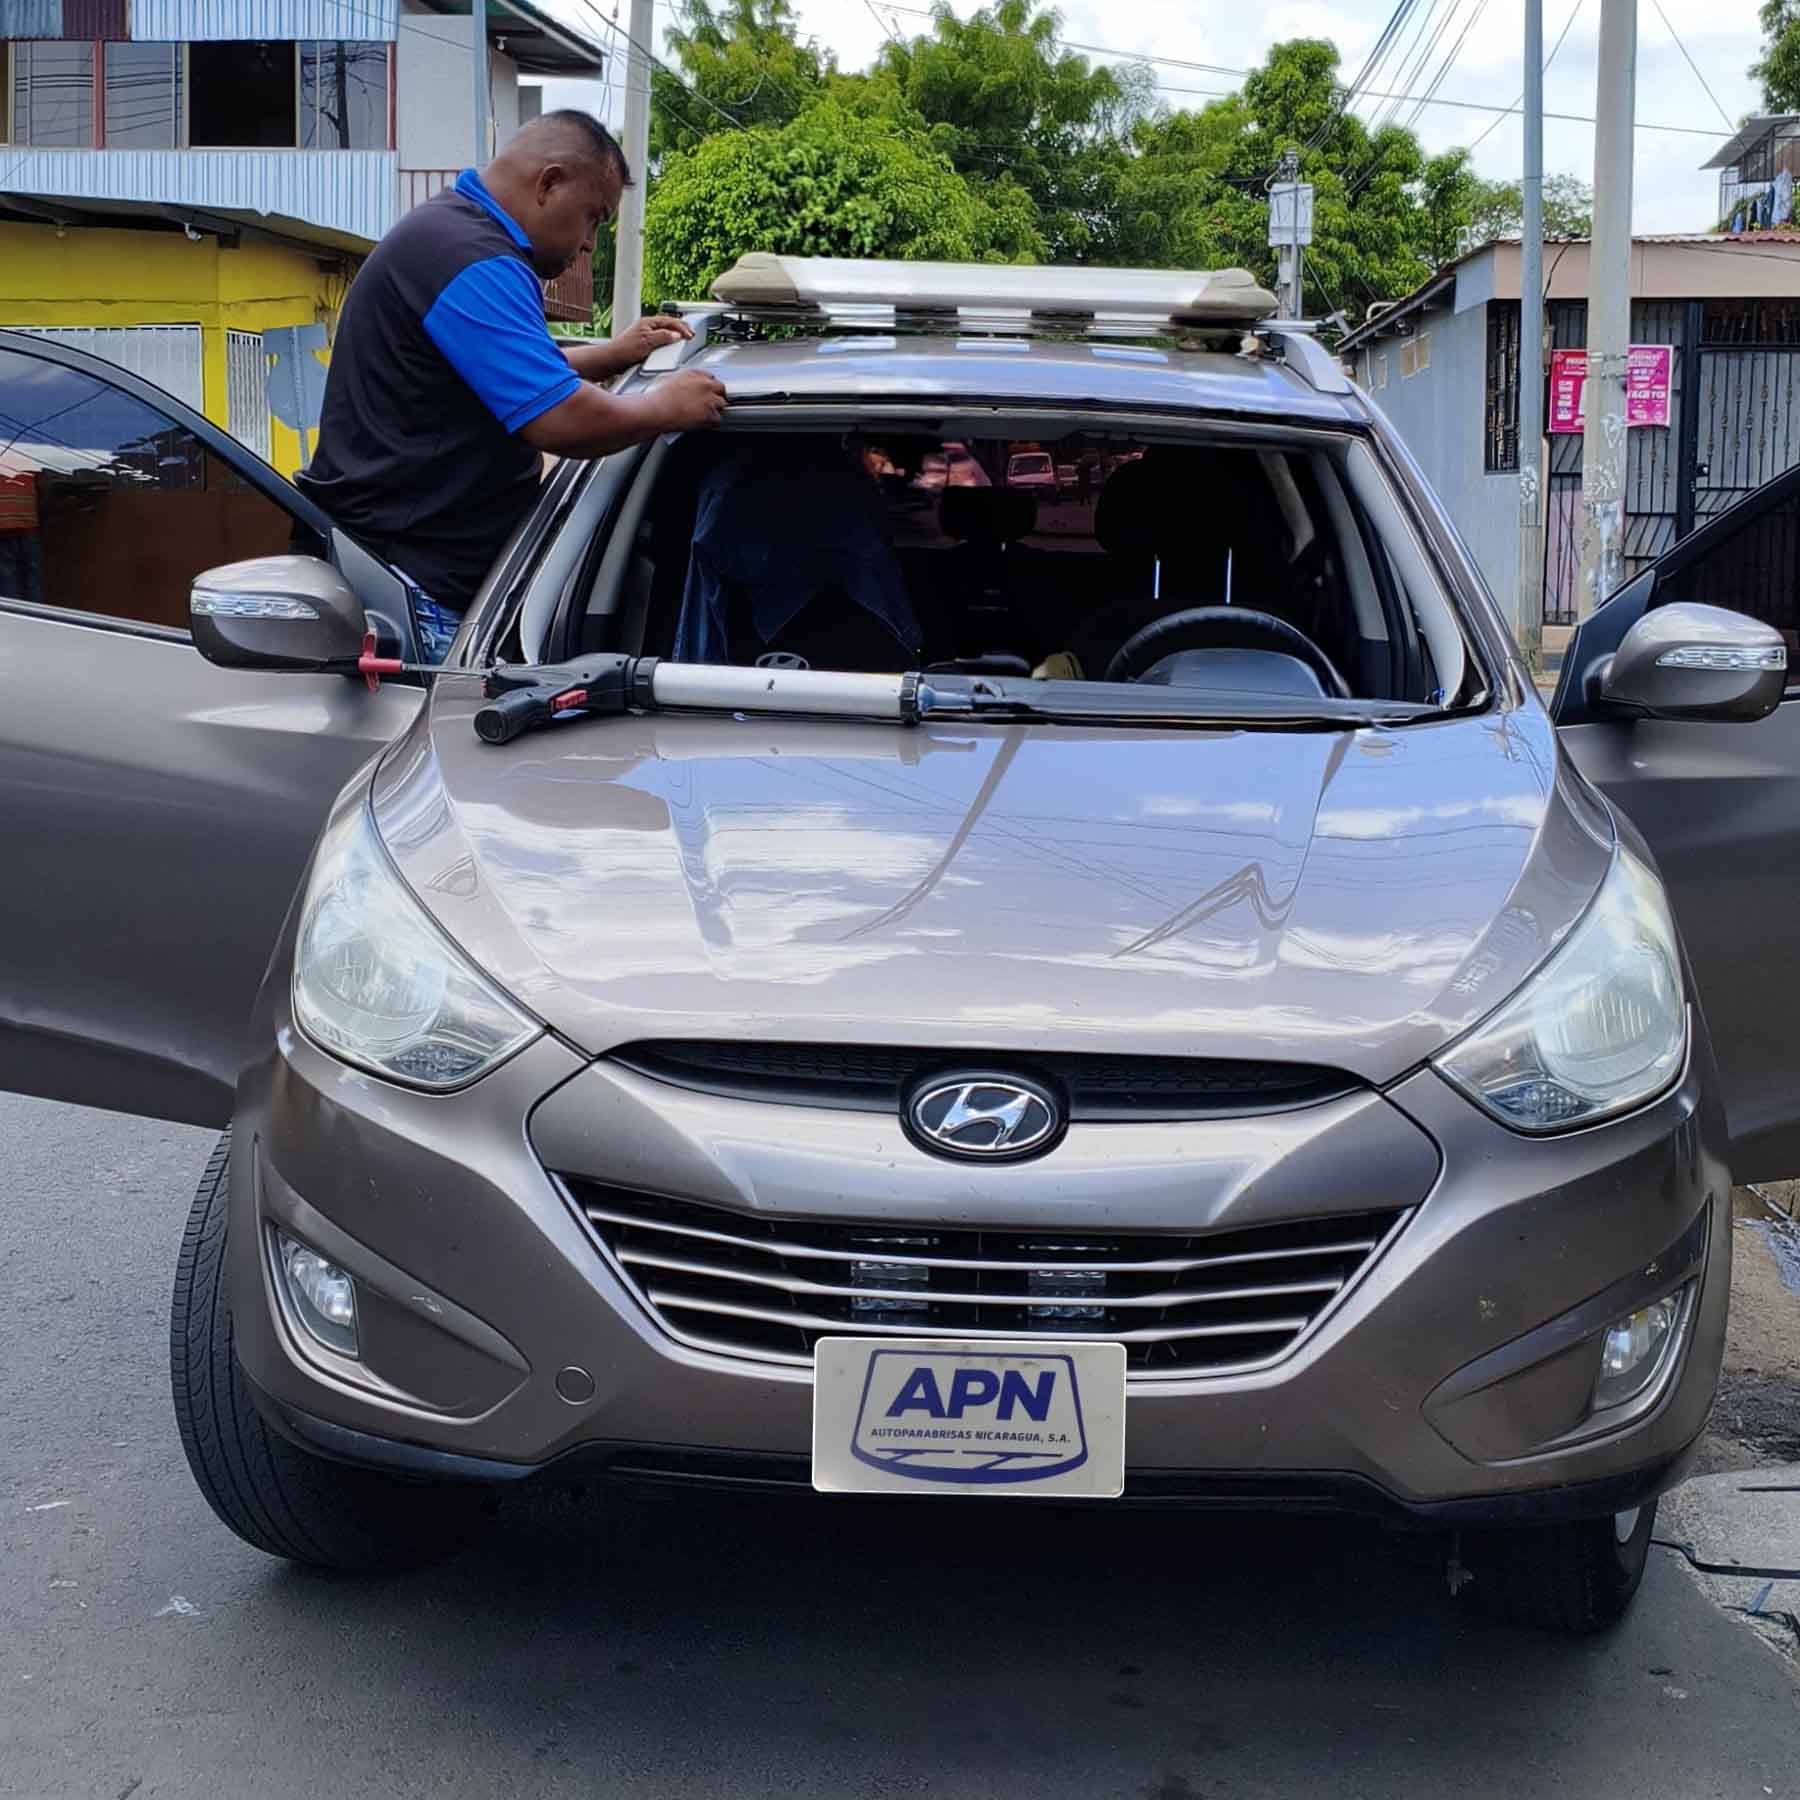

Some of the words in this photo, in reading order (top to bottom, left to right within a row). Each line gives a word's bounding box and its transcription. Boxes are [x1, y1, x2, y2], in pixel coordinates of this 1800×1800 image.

[885, 1367, 1056, 1421] APN
[870, 1428, 972, 1440] AUTOPARABRISAS
[975, 1430, 1045, 1444] NICARAGUA,
[1048, 1433, 1071, 1444] S.A.
